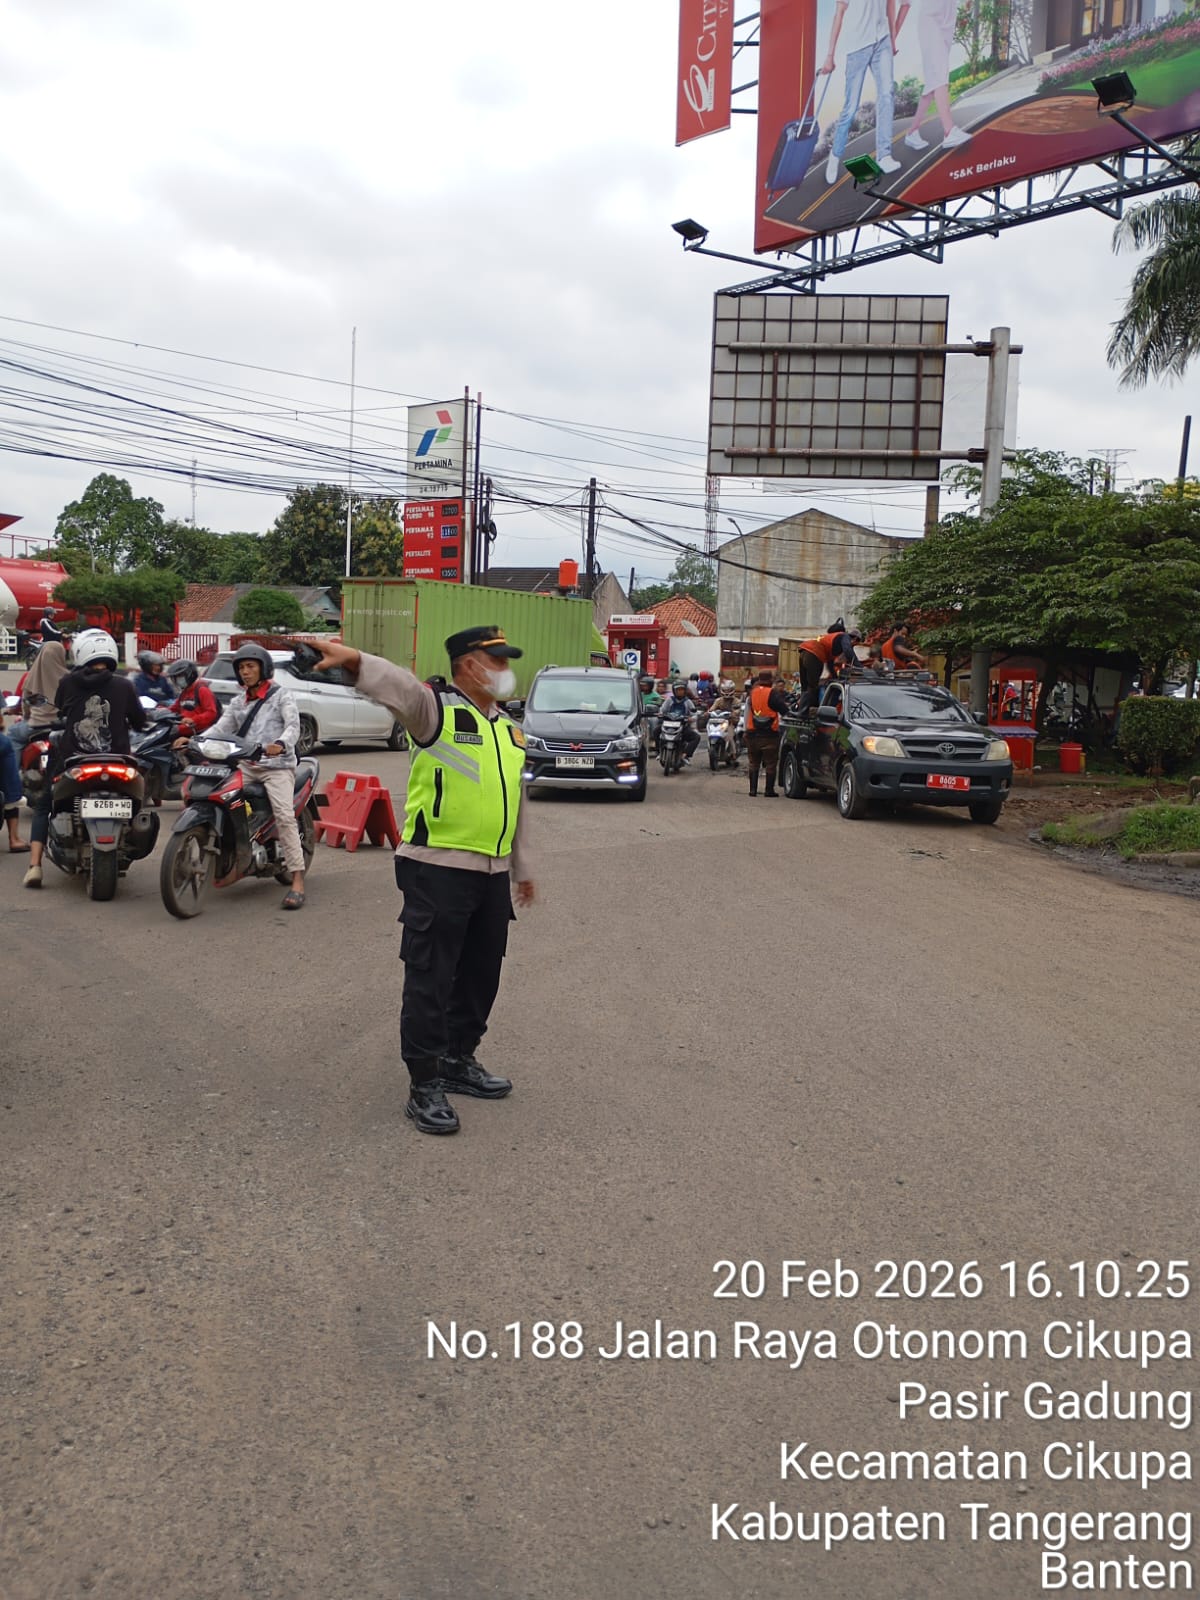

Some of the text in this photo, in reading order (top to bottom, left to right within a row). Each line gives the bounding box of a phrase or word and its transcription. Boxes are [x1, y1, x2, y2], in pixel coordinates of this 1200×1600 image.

[976, 155, 1017, 173] Berlaku
[414, 458, 453, 471] PERTAMINA
[82, 800, 88, 809] Z
